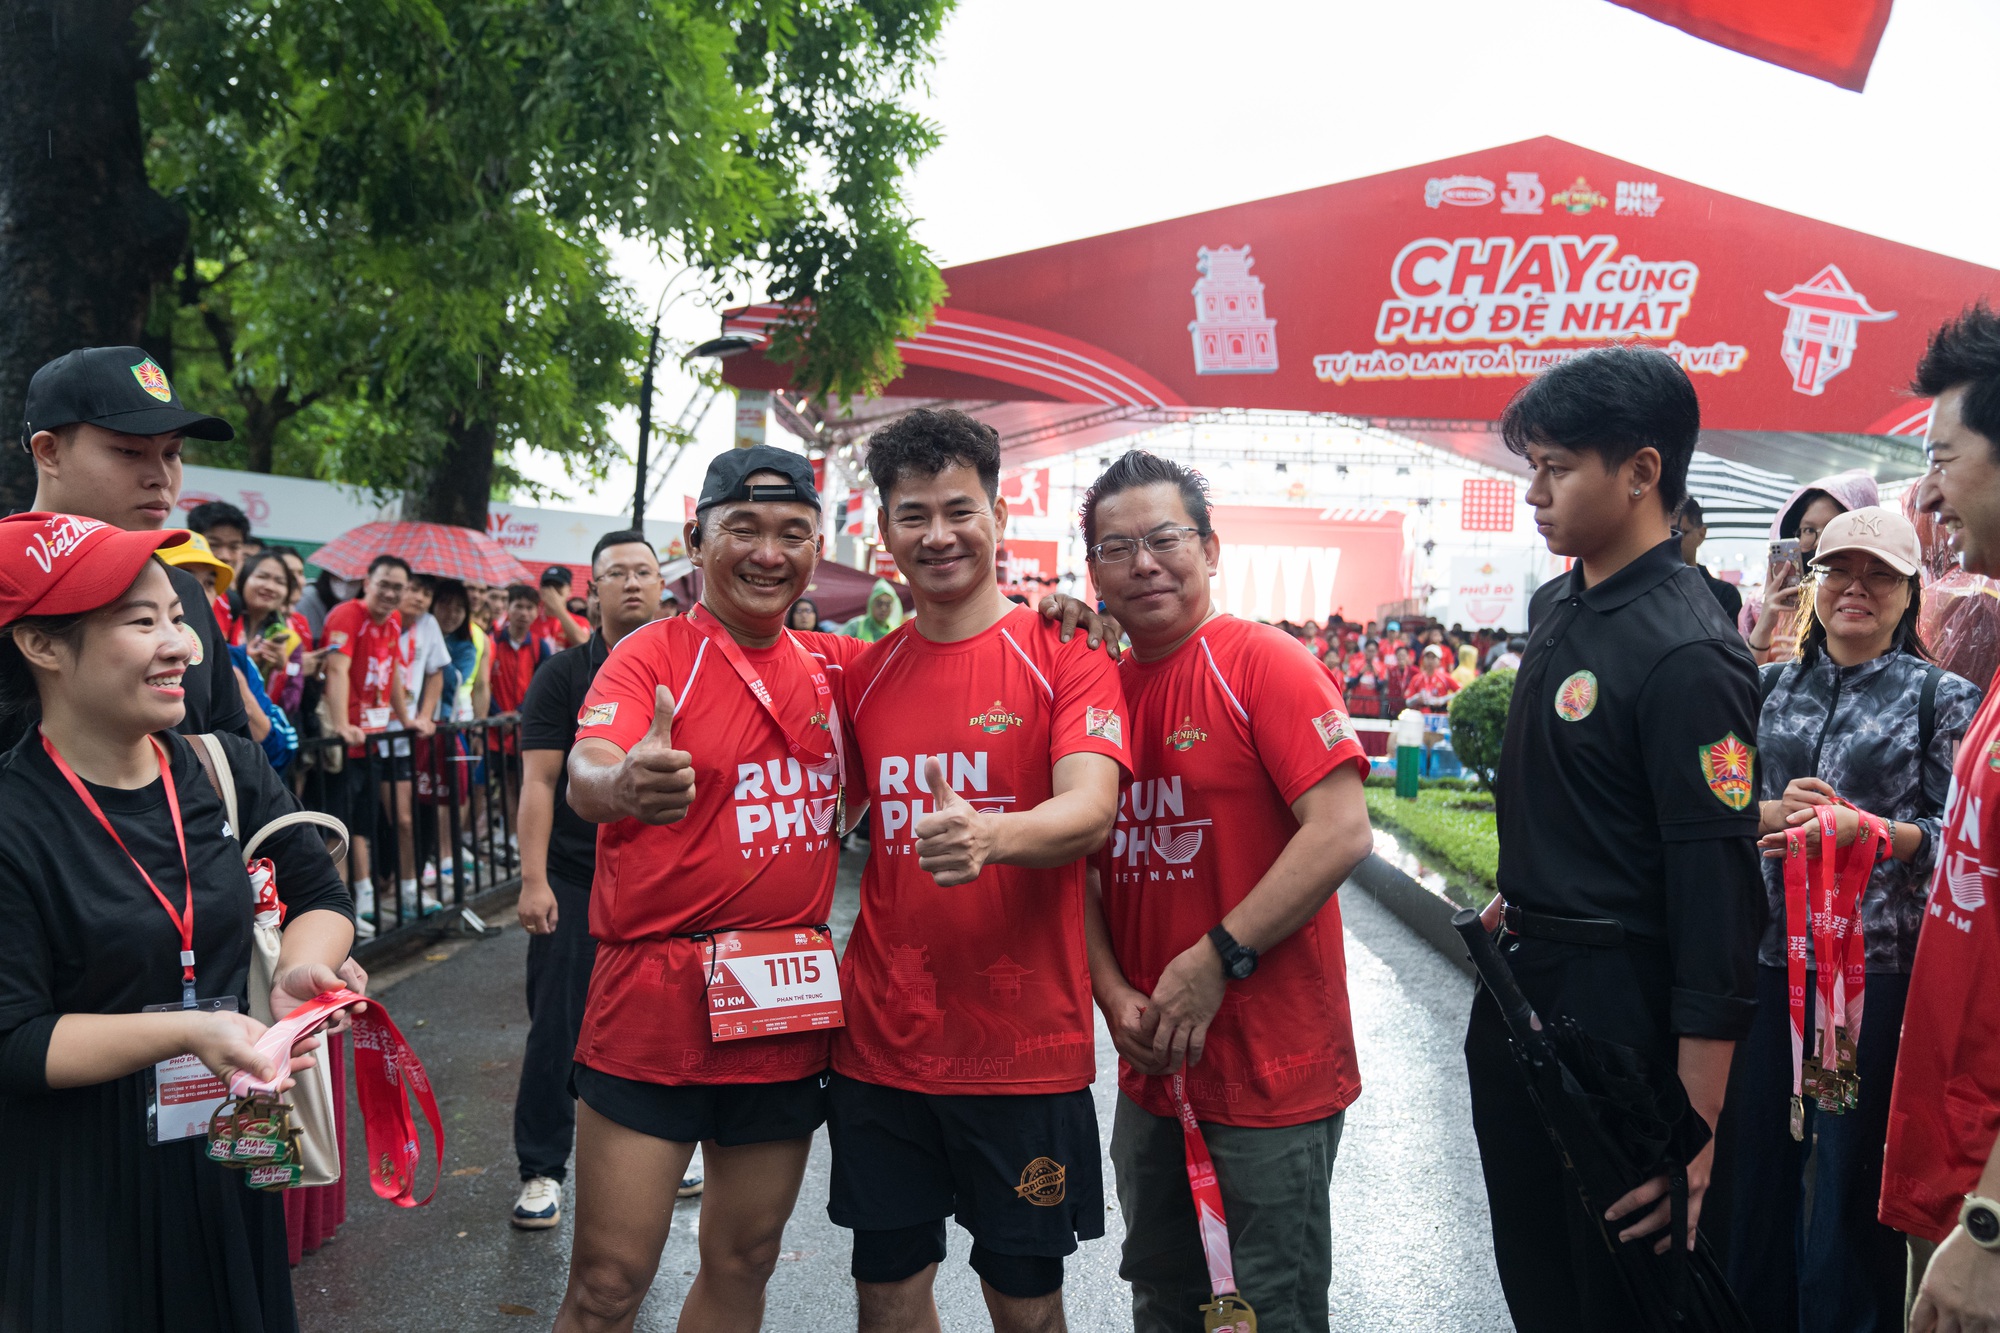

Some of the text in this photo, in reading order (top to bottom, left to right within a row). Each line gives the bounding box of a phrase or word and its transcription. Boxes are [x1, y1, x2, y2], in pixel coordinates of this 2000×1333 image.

[1398, 242, 1691, 299] CHẠY CÙNG
[1382, 291, 1682, 339] PHỞ ĐỆ NHẤT
[1318, 357, 1349, 376] TỰ
[1354, 351, 1405, 373] HÀO
[1412, 353, 1457, 372] LAN
[1690, 349, 1740, 374] VIỆT
[811, 672, 826, 685] 10
[755, 678, 773, 703] RUN
[969, 711, 1023, 727] ĐỆ NHẤT
[1165, 729, 1179, 746] ĐỆ
[1179, 727, 1208, 743] NHẤT
[741, 843, 792, 859] VIET
[1116, 867, 1195, 884] IET NAM
[1836, 917, 1849, 939] RUN
[1930, 902, 1972, 934] NAM
[1798, 936, 1806, 959] RUN
[764, 955, 821, 987] 1115
[794, 993, 805, 1001] THẾ
[1789, 985, 1804, 997] 10
[713, 995, 745, 1008] 10 KM
